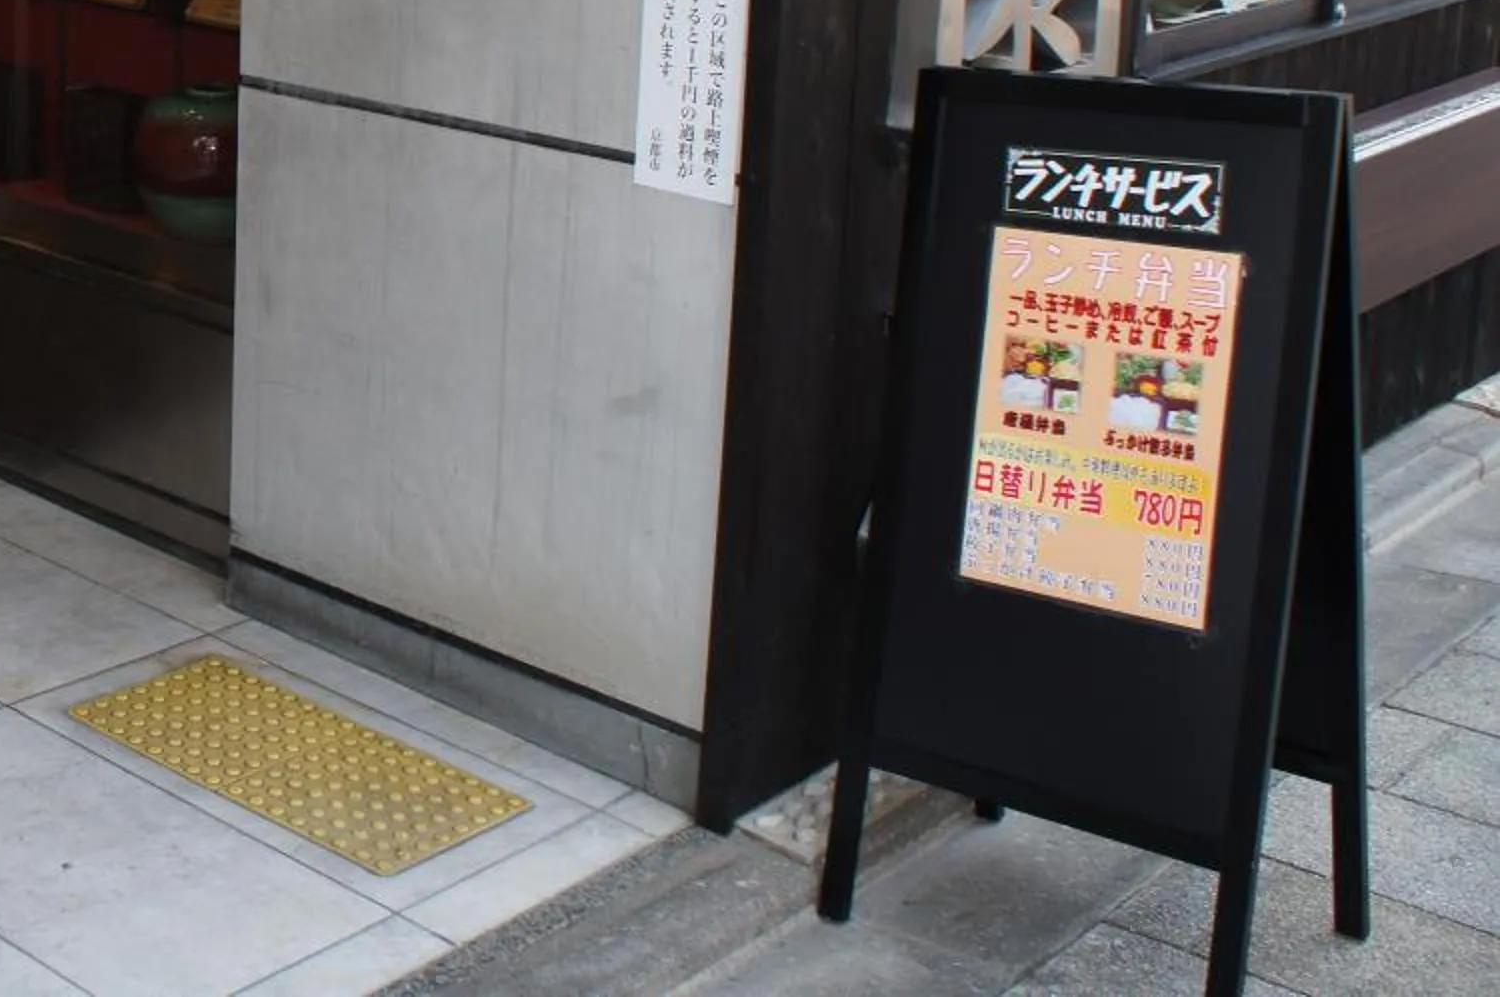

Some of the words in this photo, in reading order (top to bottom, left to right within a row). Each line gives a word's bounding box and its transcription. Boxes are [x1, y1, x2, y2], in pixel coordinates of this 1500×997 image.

[1013, 158, 1213, 219] ランチサービス
[1052, 207, 1108, 224] LUNCH
[1117, 212, 1168, 229] MENU
[1001, 238, 1227, 310] ランチ弁当
[973, 459, 1104, 516] 日替り弁当
[1132, 489, 1204, 536] 780円
